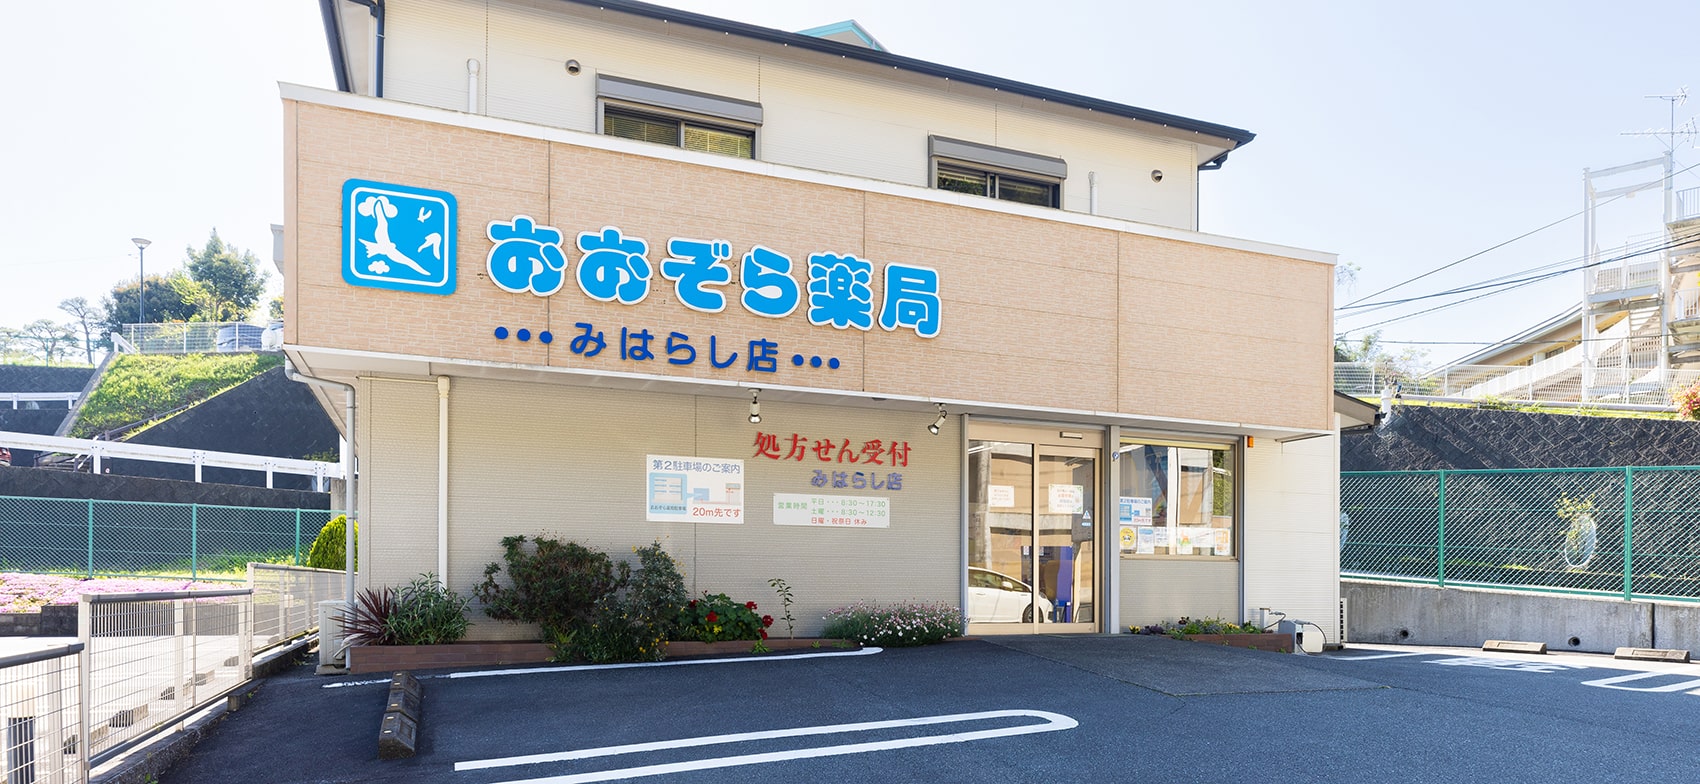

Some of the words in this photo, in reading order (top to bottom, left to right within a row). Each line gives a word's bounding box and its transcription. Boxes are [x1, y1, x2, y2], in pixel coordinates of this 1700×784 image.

[485, 215, 942, 338] おおぞら薬局
[752, 431, 912, 468] 処方せん受付
[653, 459, 741, 474] 第2駐車場のご案内
[811, 469, 902, 490] みはらし店
[692, 507, 741, 518] 20m先です
[777, 502, 808, 510] 営業時間
